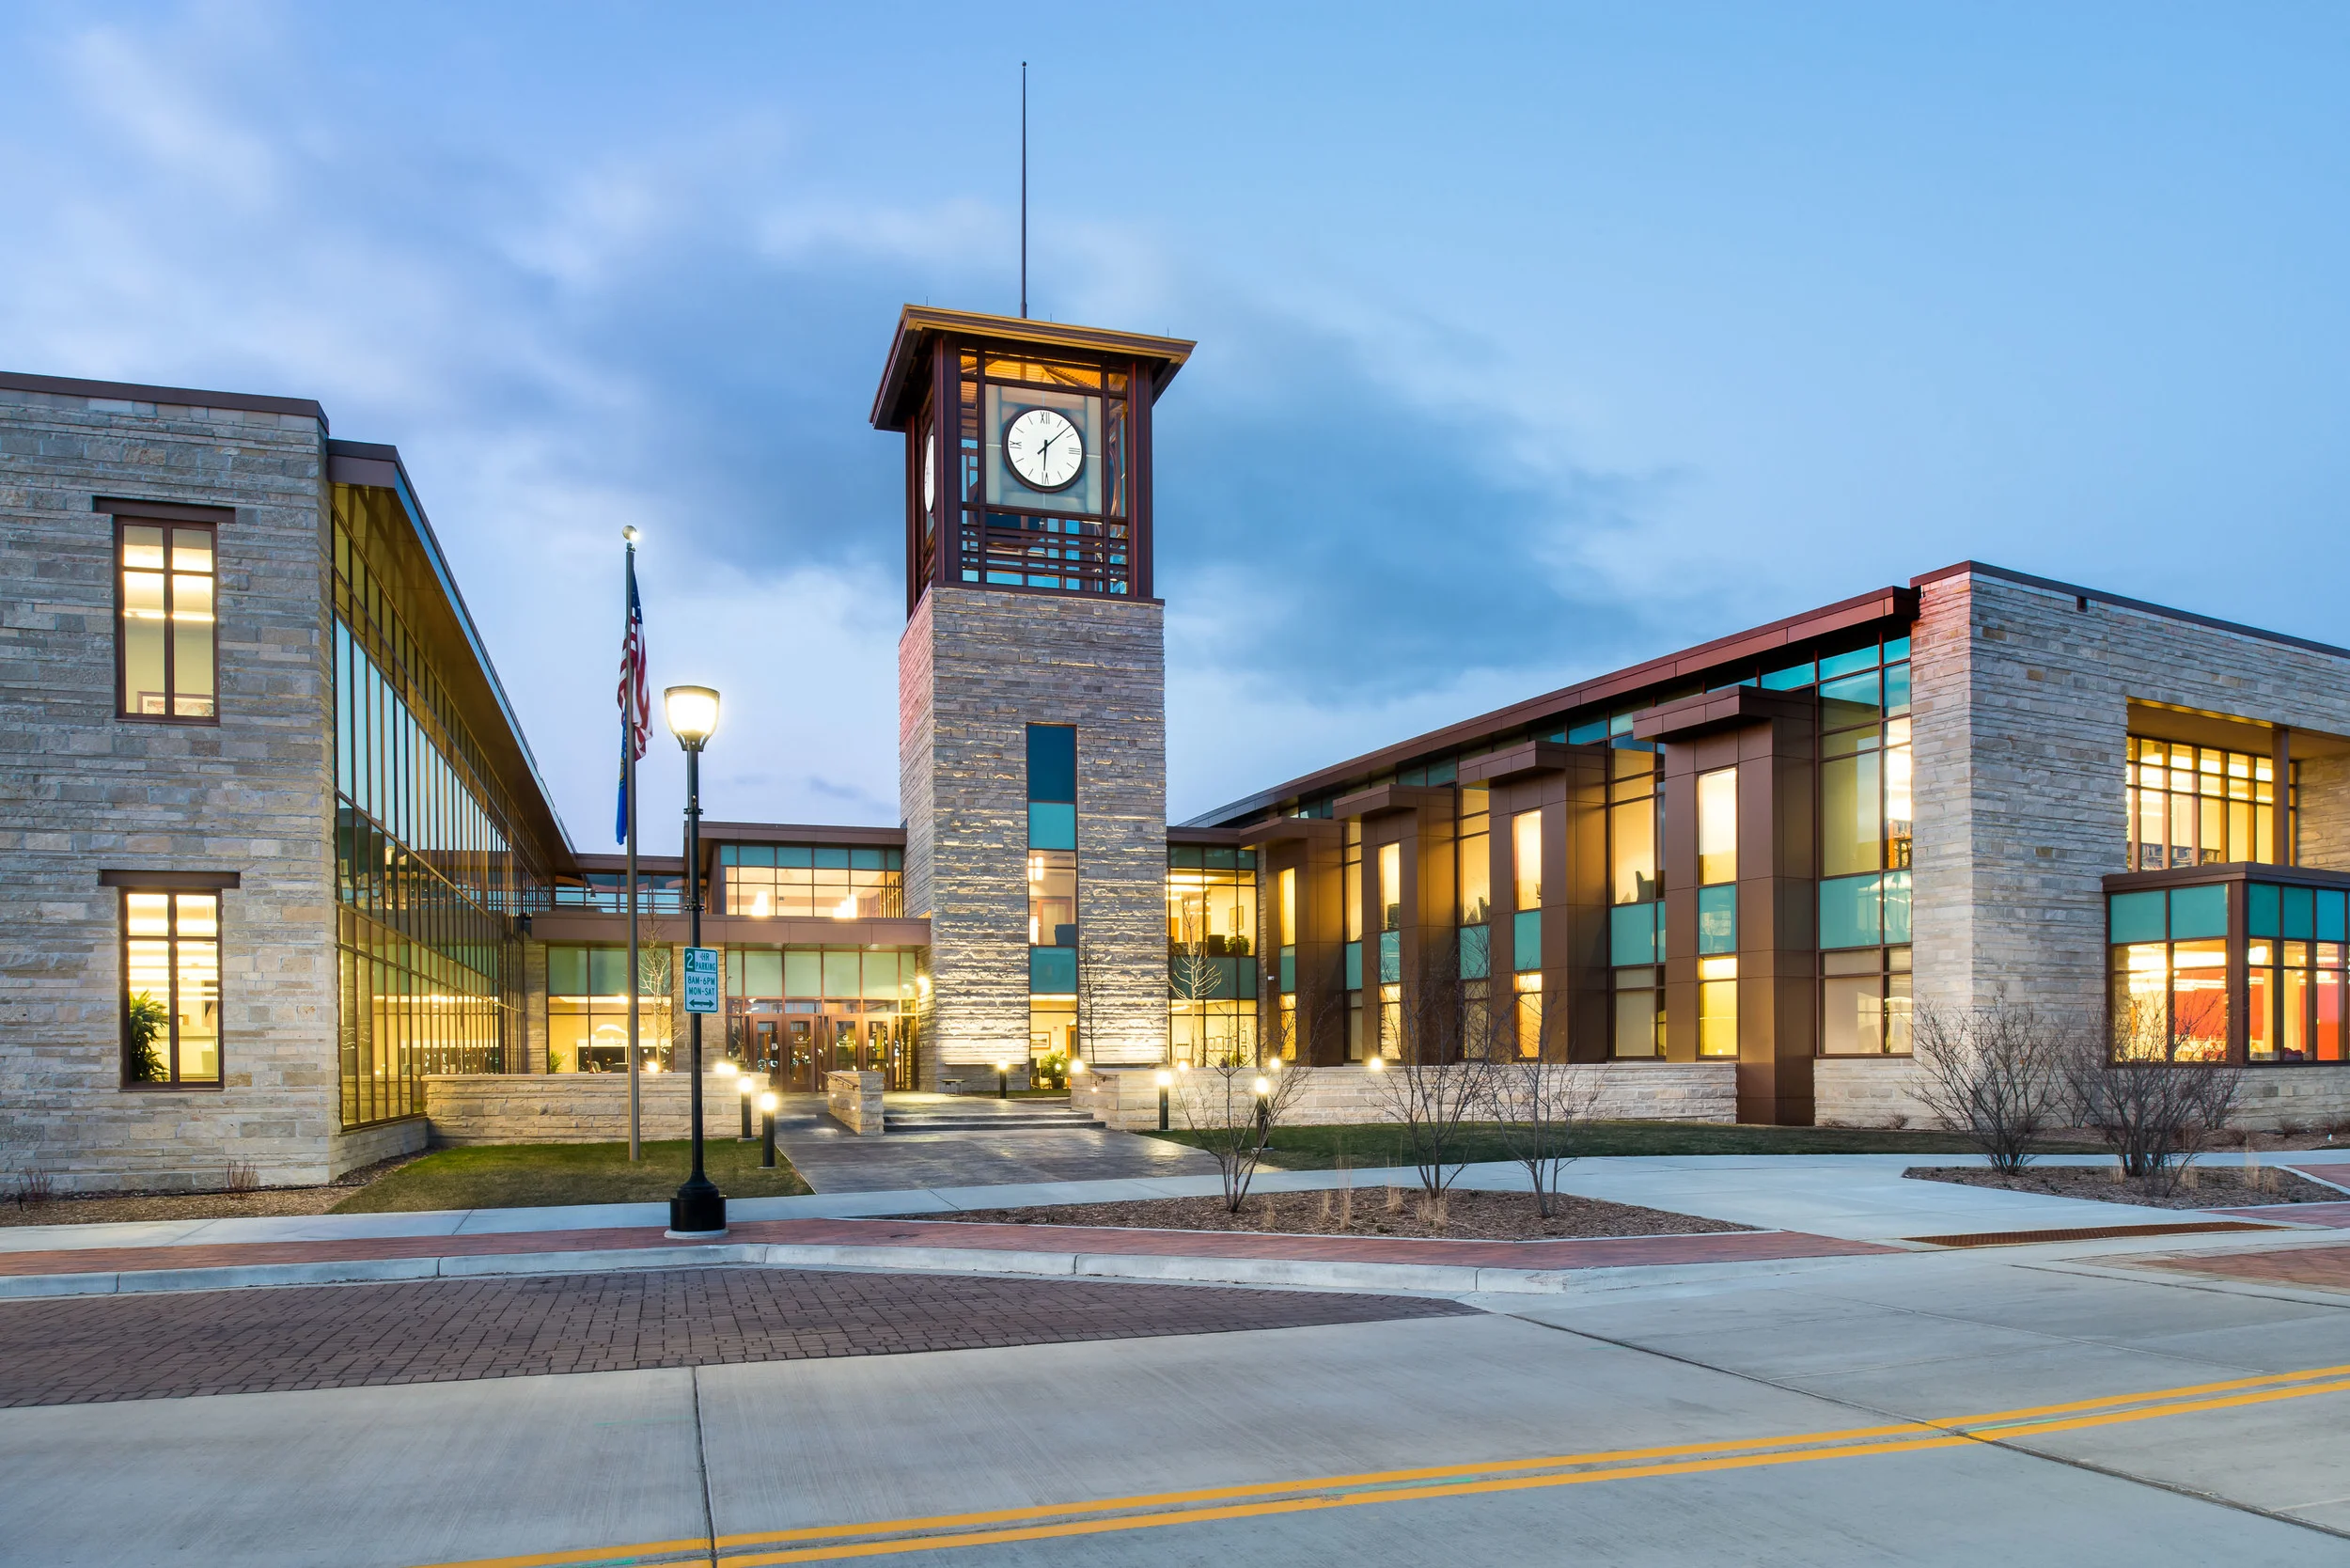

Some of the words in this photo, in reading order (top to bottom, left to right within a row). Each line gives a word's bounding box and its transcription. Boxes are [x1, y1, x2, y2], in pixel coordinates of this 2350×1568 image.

[686, 952, 694, 968] 2
[696, 963, 715, 971] PARKING
[688, 976, 714, 985] 8AM-6PM
[688, 987, 714, 996] MON-SAT
